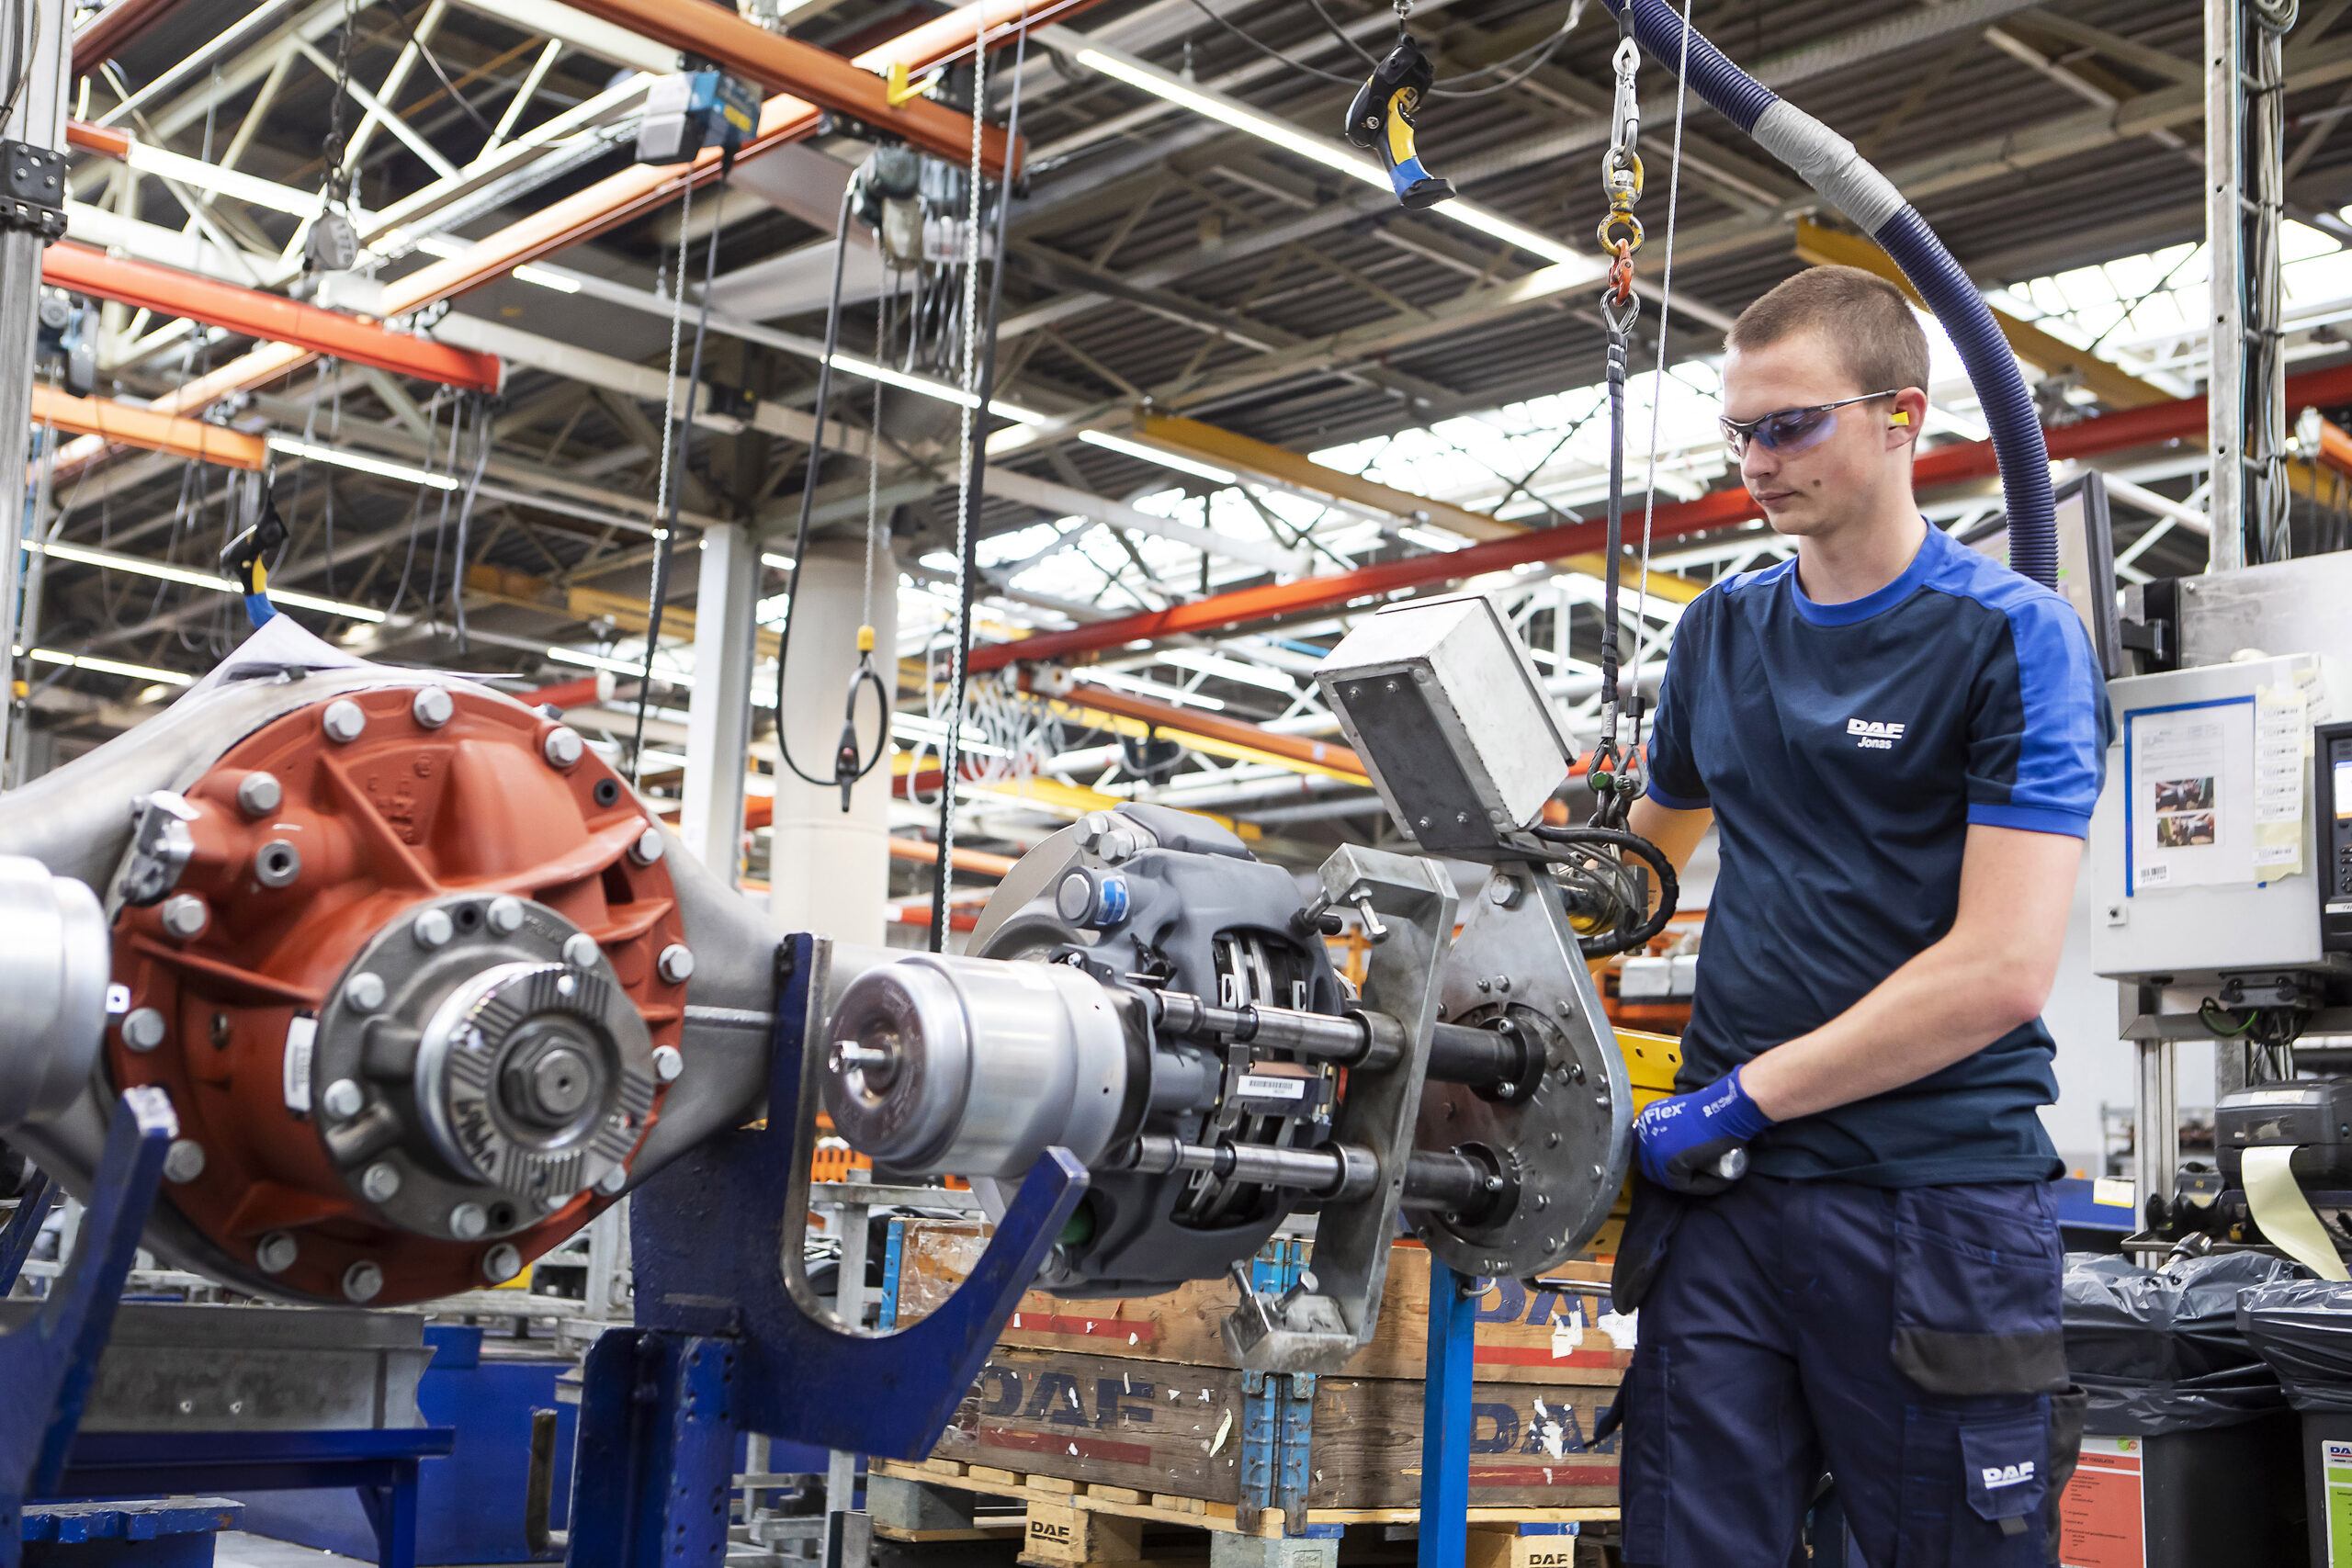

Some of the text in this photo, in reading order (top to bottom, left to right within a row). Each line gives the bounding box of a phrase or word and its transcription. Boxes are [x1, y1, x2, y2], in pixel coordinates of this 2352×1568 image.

[1847, 718, 1905, 736] DAF
[1857, 736, 1893, 750] Jonas
[1475, 1278, 1613, 1327] DA
[979, 1365, 1155, 1429] DAF
[2330, 1446, 2352, 1454] DA
[1982, 1461, 2035, 1483] DAF
[1031, 1520, 1070, 1537] DAF
[1529, 1553, 1567, 1565] DAF
